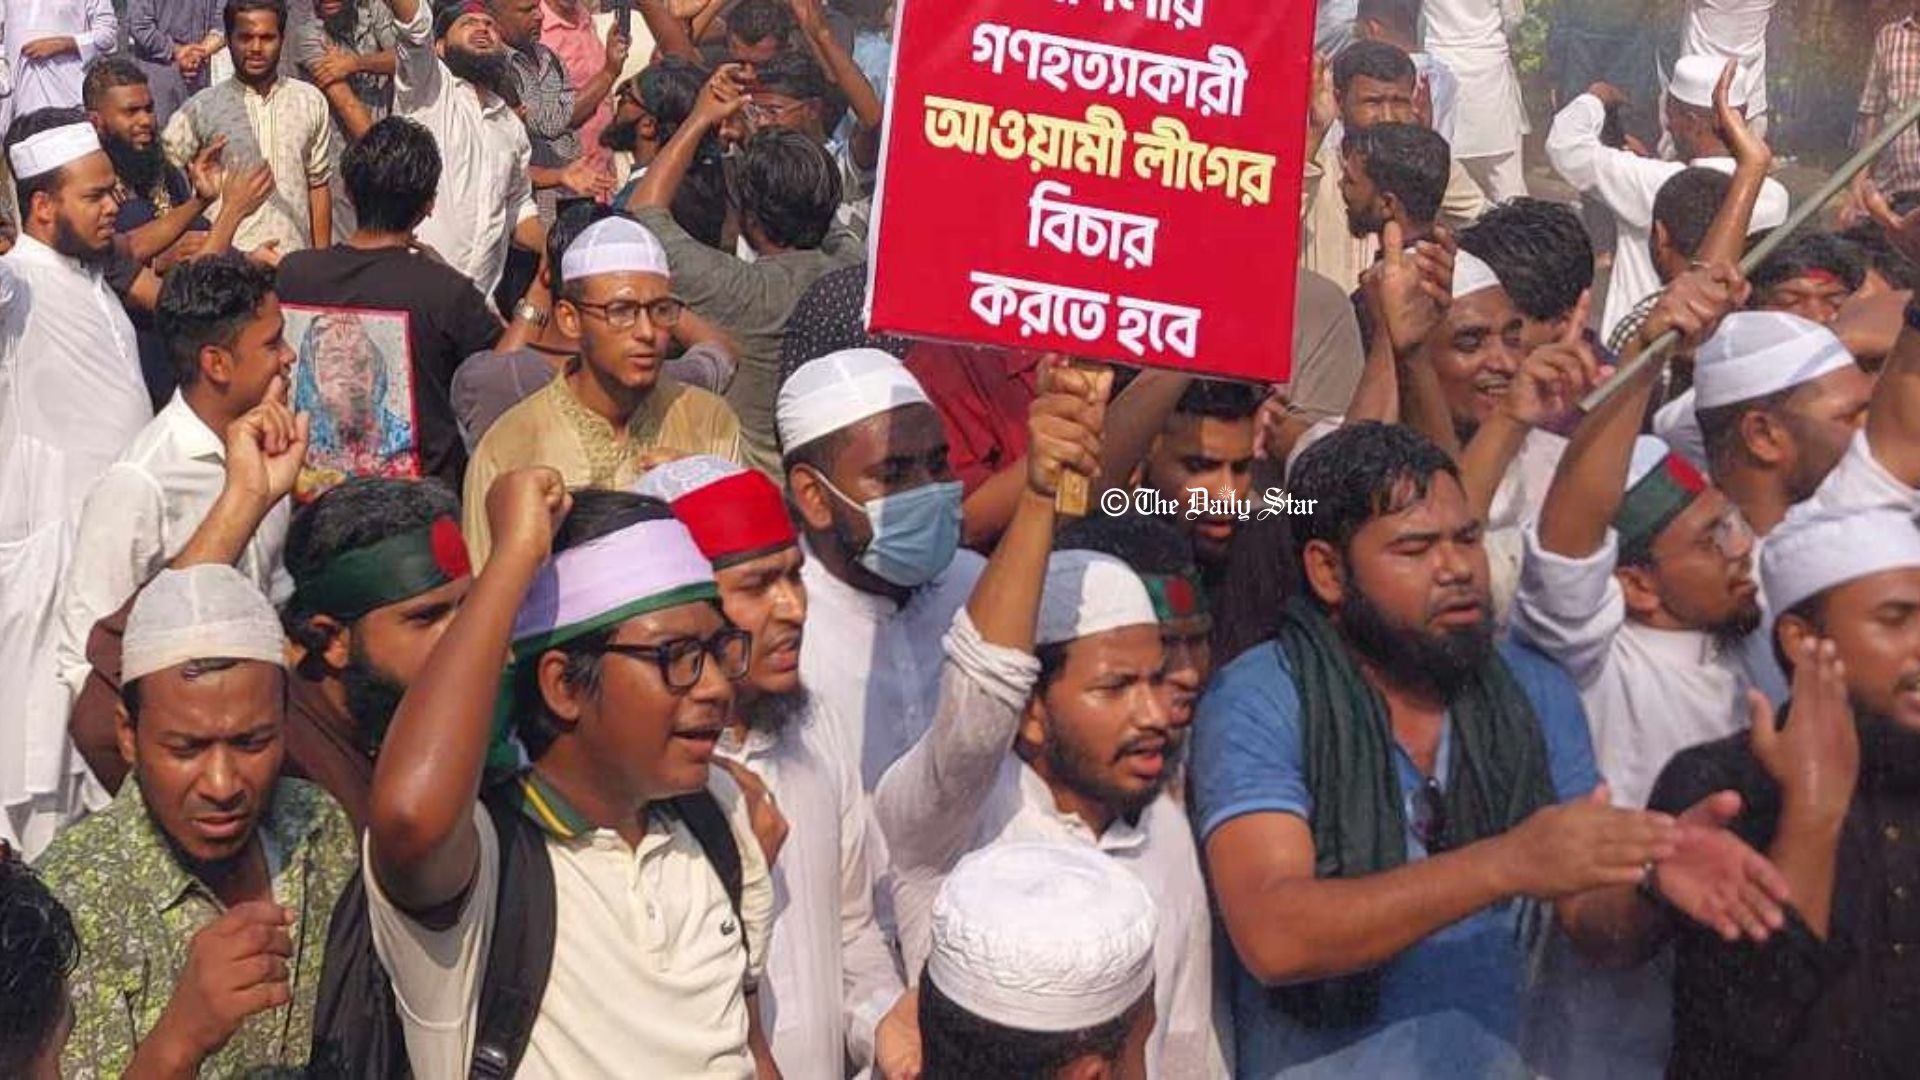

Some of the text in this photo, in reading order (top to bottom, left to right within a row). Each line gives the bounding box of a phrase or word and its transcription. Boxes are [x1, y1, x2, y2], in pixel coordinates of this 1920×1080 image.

[973, 23, 1249, 116] গণহত্যাকারী
[925, 96, 1276, 206] আওয়ামী লীগের
[1029, 181, 1159, 269] বিচার
[969, 272, 1201, 358] করতে হবে
